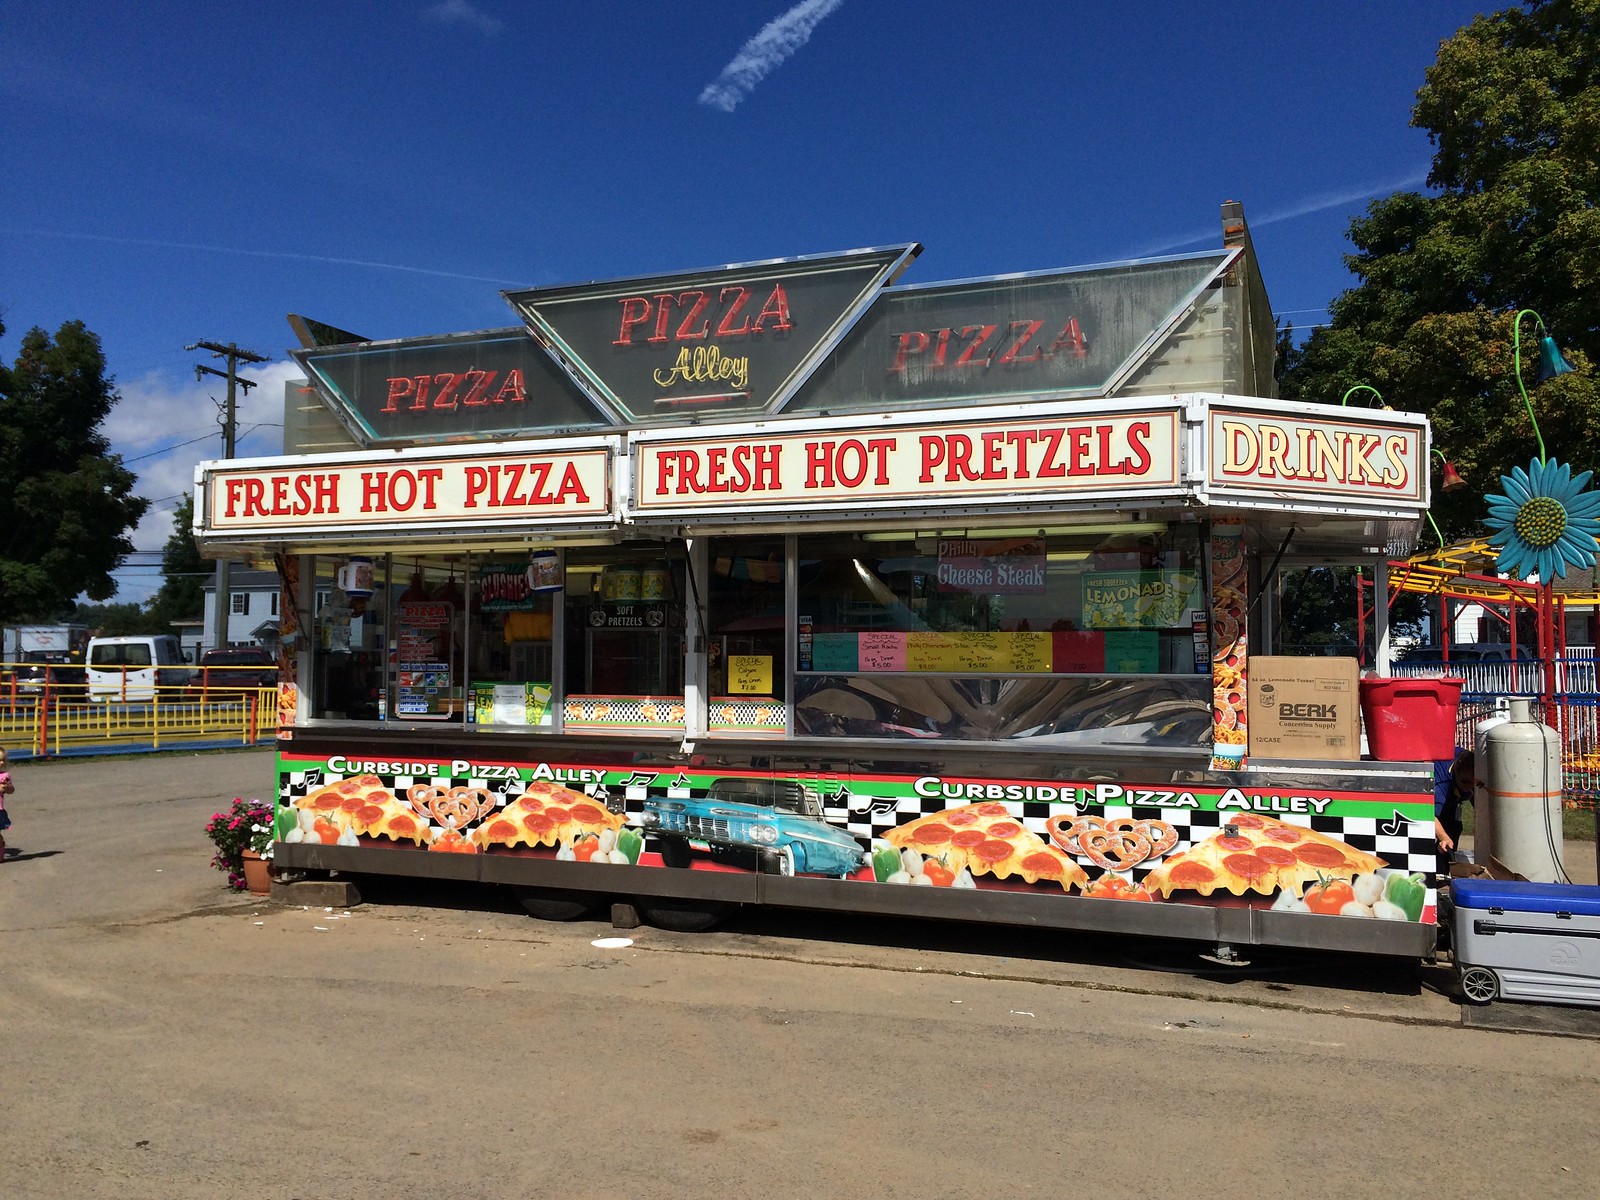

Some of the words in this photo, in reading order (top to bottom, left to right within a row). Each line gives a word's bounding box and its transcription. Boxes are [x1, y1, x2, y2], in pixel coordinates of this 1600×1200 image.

[612, 283, 792, 345] PIZZA
[886, 315, 1090, 373] PIZZA
[654, 345, 748, 388] Alley
[380, 366, 528, 414] PIZZA
[656, 444, 782, 495] FRESH
[805, 438, 896, 488] HOT
[919, 421, 1151, 483] PRETZELS
[1222, 421, 1409, 489] DRINKS
[225, 473, 340, 518] FRESH
[360, 468, 443, 512] HOT
[464, 461, 590, 508] PIZZA
[938, 541, 978, 561] Philly
[937, 564, 992, 585] Cheese
[997, 564, 1044, 586] Steak
[1087, 581, 1173, 604] LEMONADE
[405, 607, 446, 616] PIZZA
[608, 617, 643, 626] PRETZELS
[617, 606, 634, 615] SOFT
[1279, 703, 1337, 718] BERK
[1314, 722, 1336, 730] Supply
[327, 755, 439, 777] CURBSIDE
[451, 759, 520, 780] PIZZA
[531, 763, 607, 783] ALLEY
[913, 776, 1076, 803] CURBSIDE
[1095, 783, 1200, 808] PIZZA
[1215, 788, 1333, 815] ALLEY
